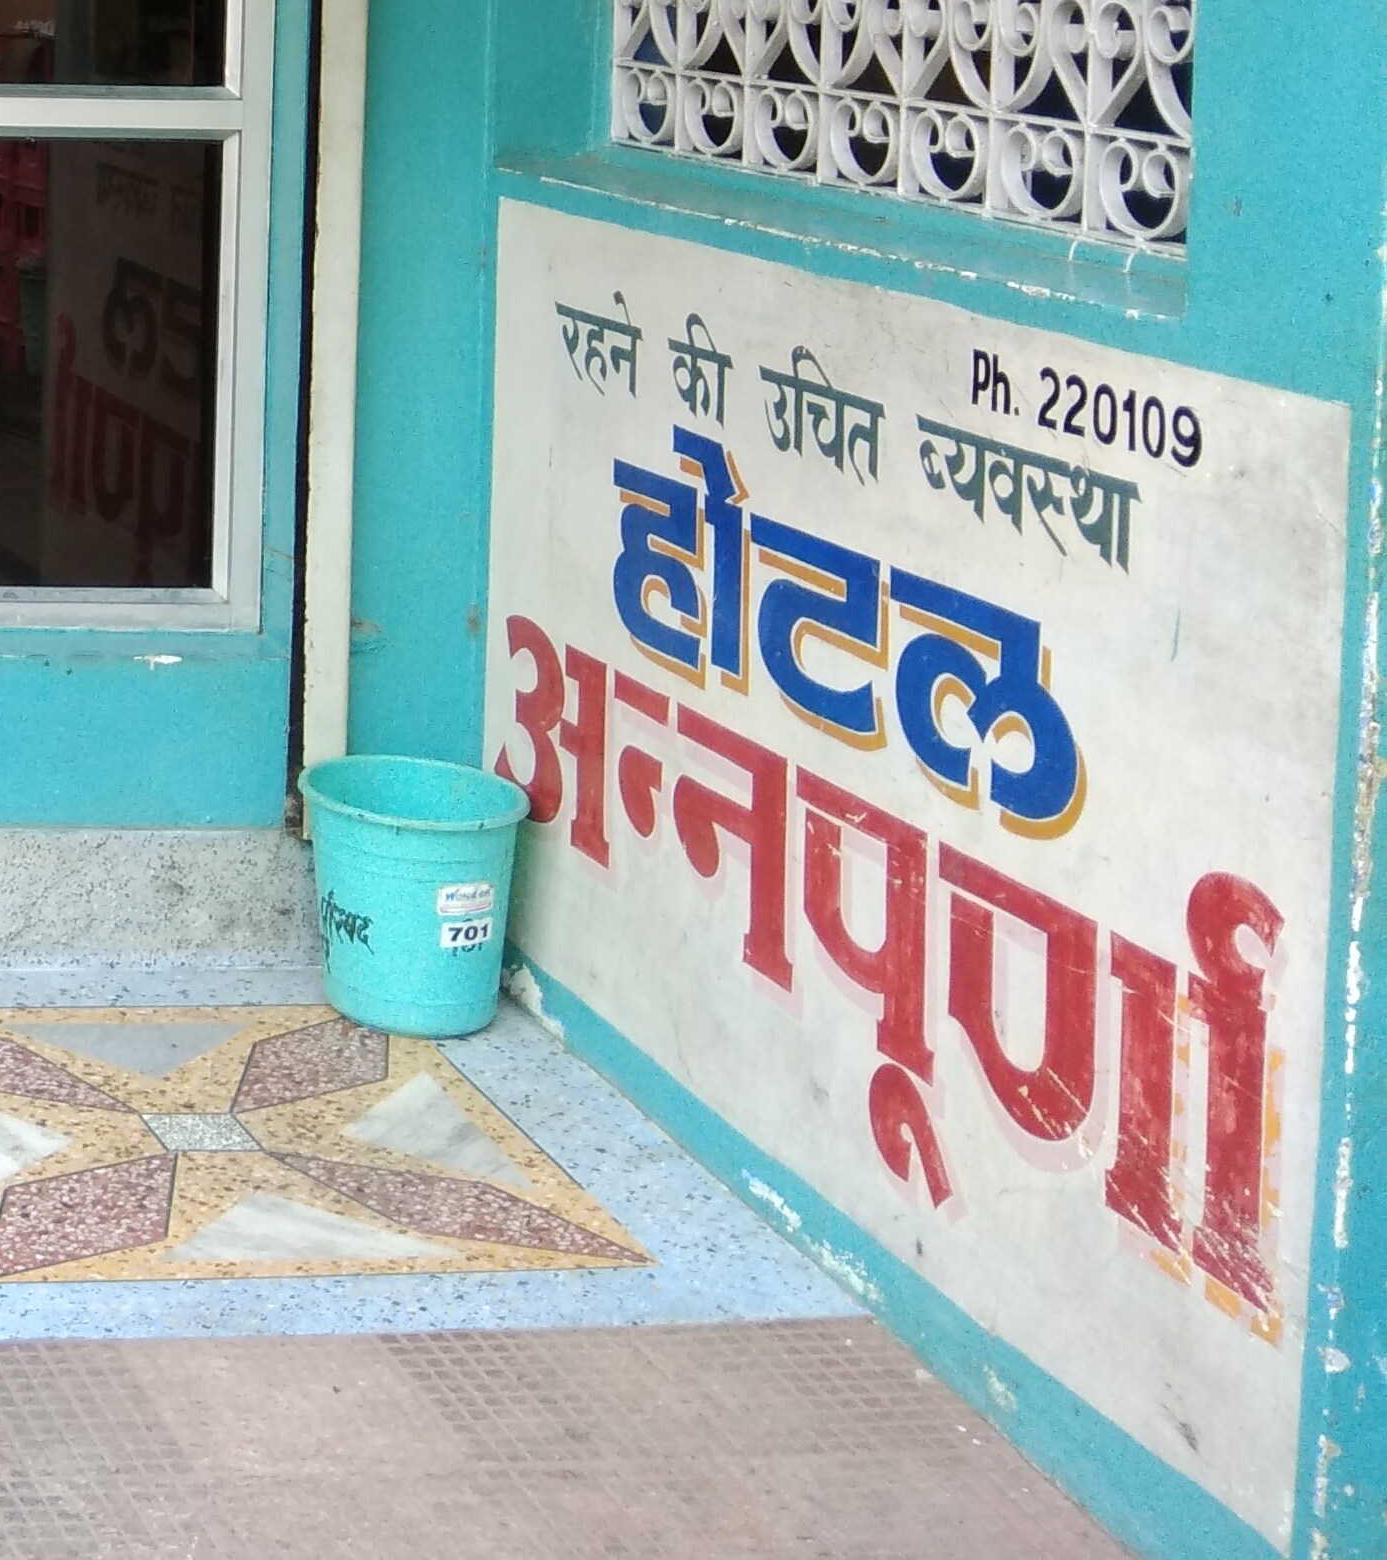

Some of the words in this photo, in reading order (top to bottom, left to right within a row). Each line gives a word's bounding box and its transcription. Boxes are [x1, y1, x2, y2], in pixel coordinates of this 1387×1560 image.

[554, 291, 642, 397] रहने
[667, 312, 732, 428] की
[759, 345, 885, 485] उचित
[971, 348, 1020, 416] Ph.
[1037, 366, 1203, 467] 220109
[612, 424, 1088, 840] होटल
[448, 923, 488, 942] 701
[494, 614, 1285, 1320] अन्नपूर्णा
